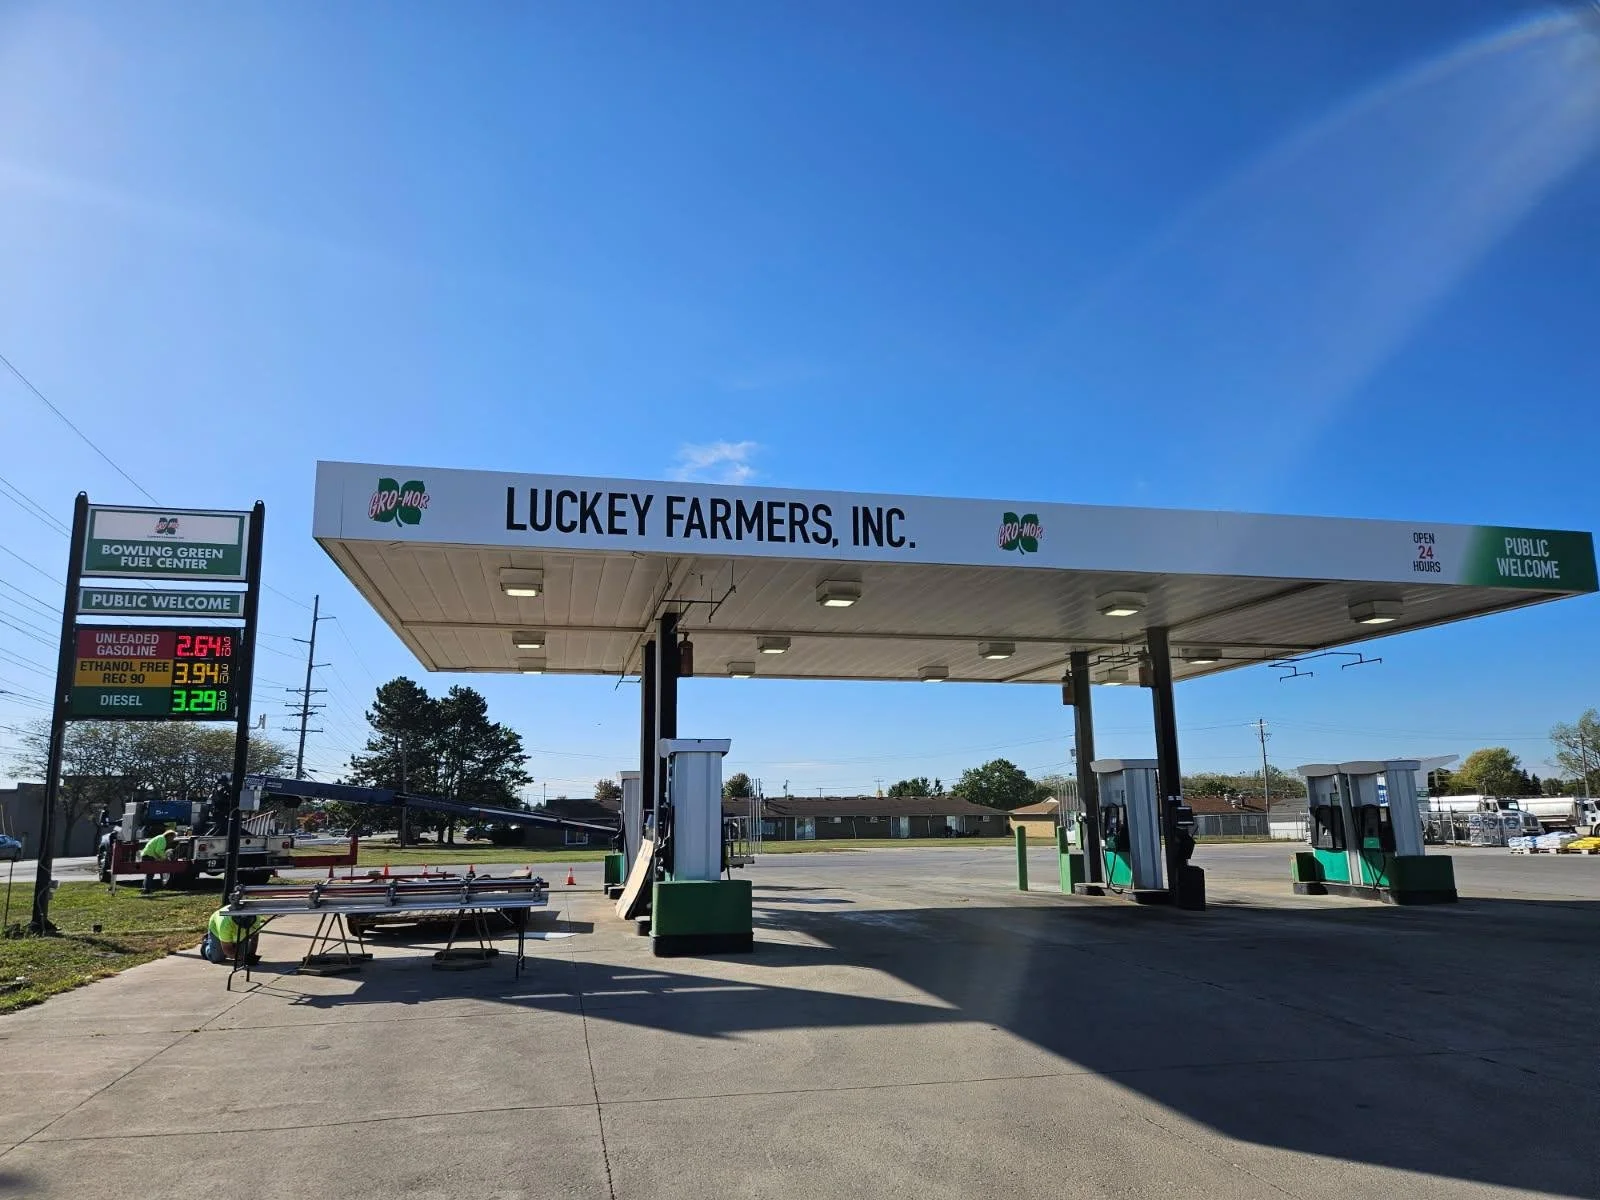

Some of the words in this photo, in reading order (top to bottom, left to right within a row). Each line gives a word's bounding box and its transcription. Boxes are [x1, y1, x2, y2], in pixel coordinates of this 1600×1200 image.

[506, 486, 653, 537] LUCKEY
[667, 496, 838, 548] FARMERS,
[852, 506, 917, 549] INC.
[1413, 532, 1435, 544] OPEN
[102, 544, 172, 557] BOWLING
[177, 547, 223, 559] GREEN
[1418, 545, 1433, 559] 24
[1505, 537, 1549, 557] PUBLIC
[120, 557, 153, 568] FUEL
[156, 558, 208, 569] CENTER
[1413, 561, 1441, 573] HOURS
[1497, 558, 1560, 578] WELCOME
[92, 594, 148, 607] PUBLIC
[153, 597, 231, 610] WELCOME
[95, 633, 159, 645] UNLEADED
[96, 645, 157, 657] GASOLINE
[177, 636, 221, 657] 2.64
[80, 660, 136, 673] ETHANOL
[139, 661, 170, 673] FREE
[174, 663, 219, 684] 3.94
[102, 673, 127, 684] REC
[130, 674, 146, 685] 90
[100, 694, 143, 706] DIESEL
[172, 690, 216, 711] 3.29
